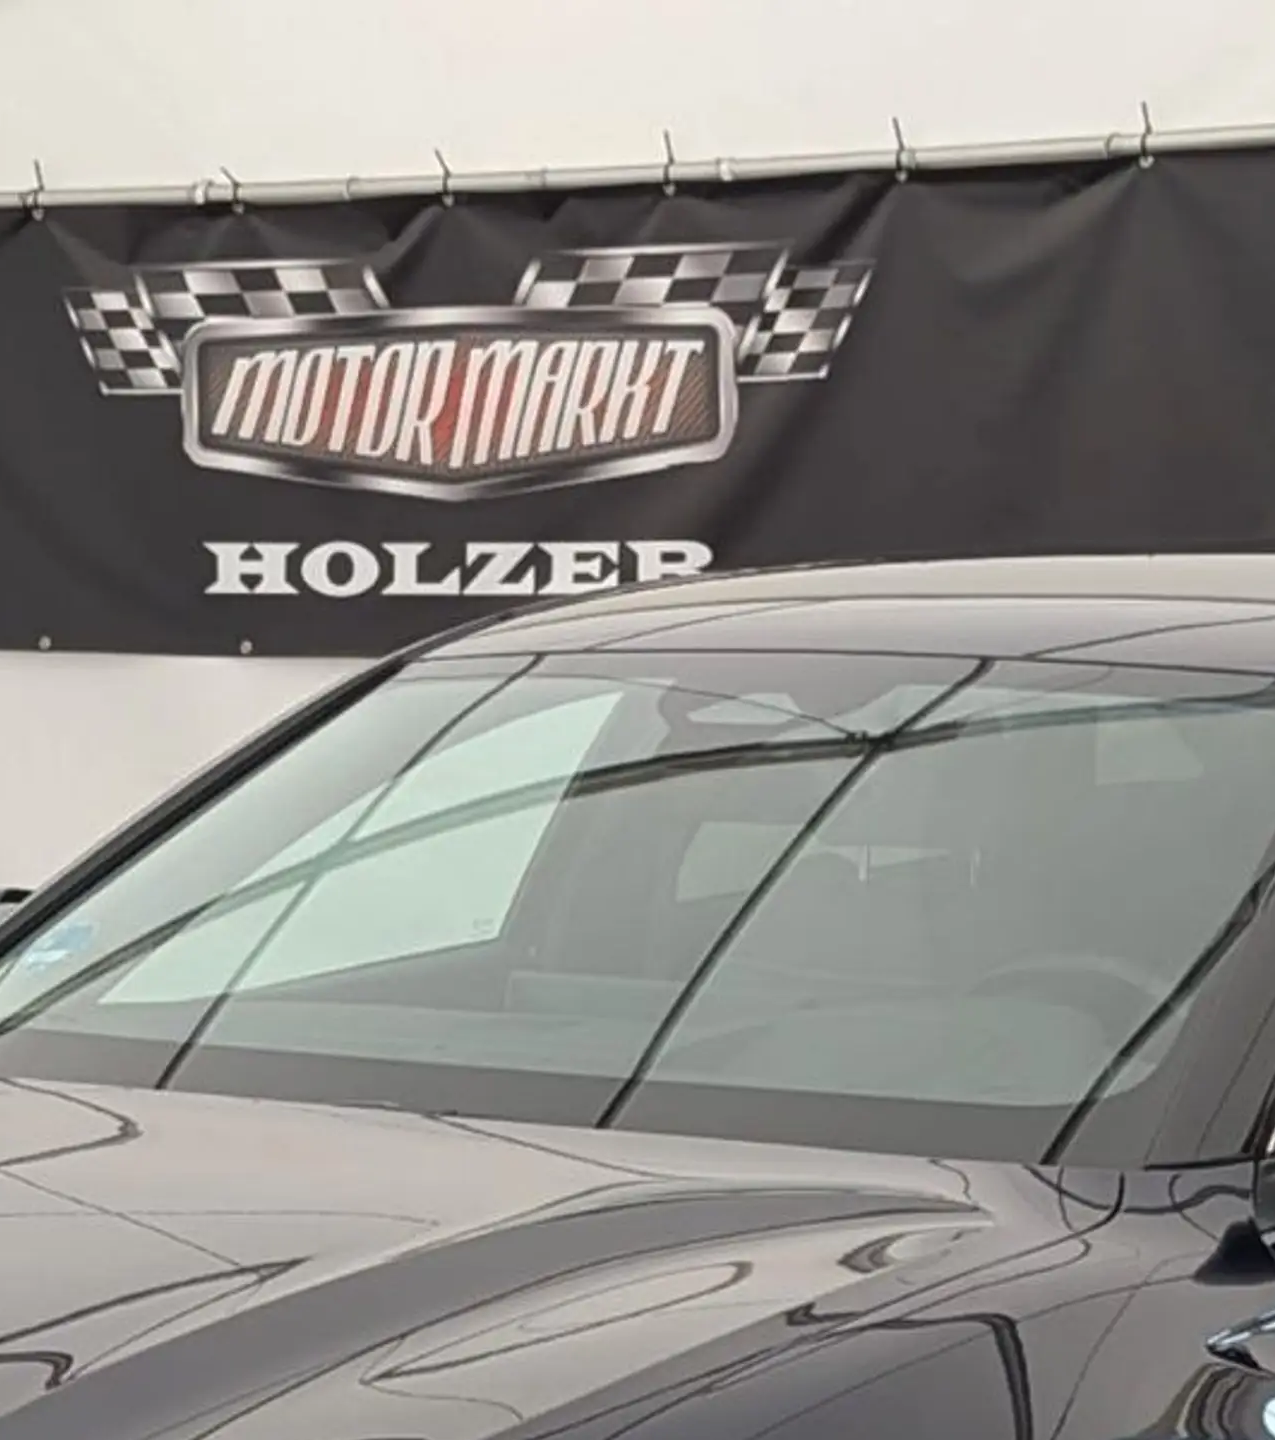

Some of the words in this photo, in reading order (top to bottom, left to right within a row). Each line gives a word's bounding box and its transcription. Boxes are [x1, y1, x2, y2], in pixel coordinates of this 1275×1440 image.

[212, 341, 455, 467] MOTOR
[449, 340, 704, 468] MARKT
[202, 540, 714, 597] HOLZER
